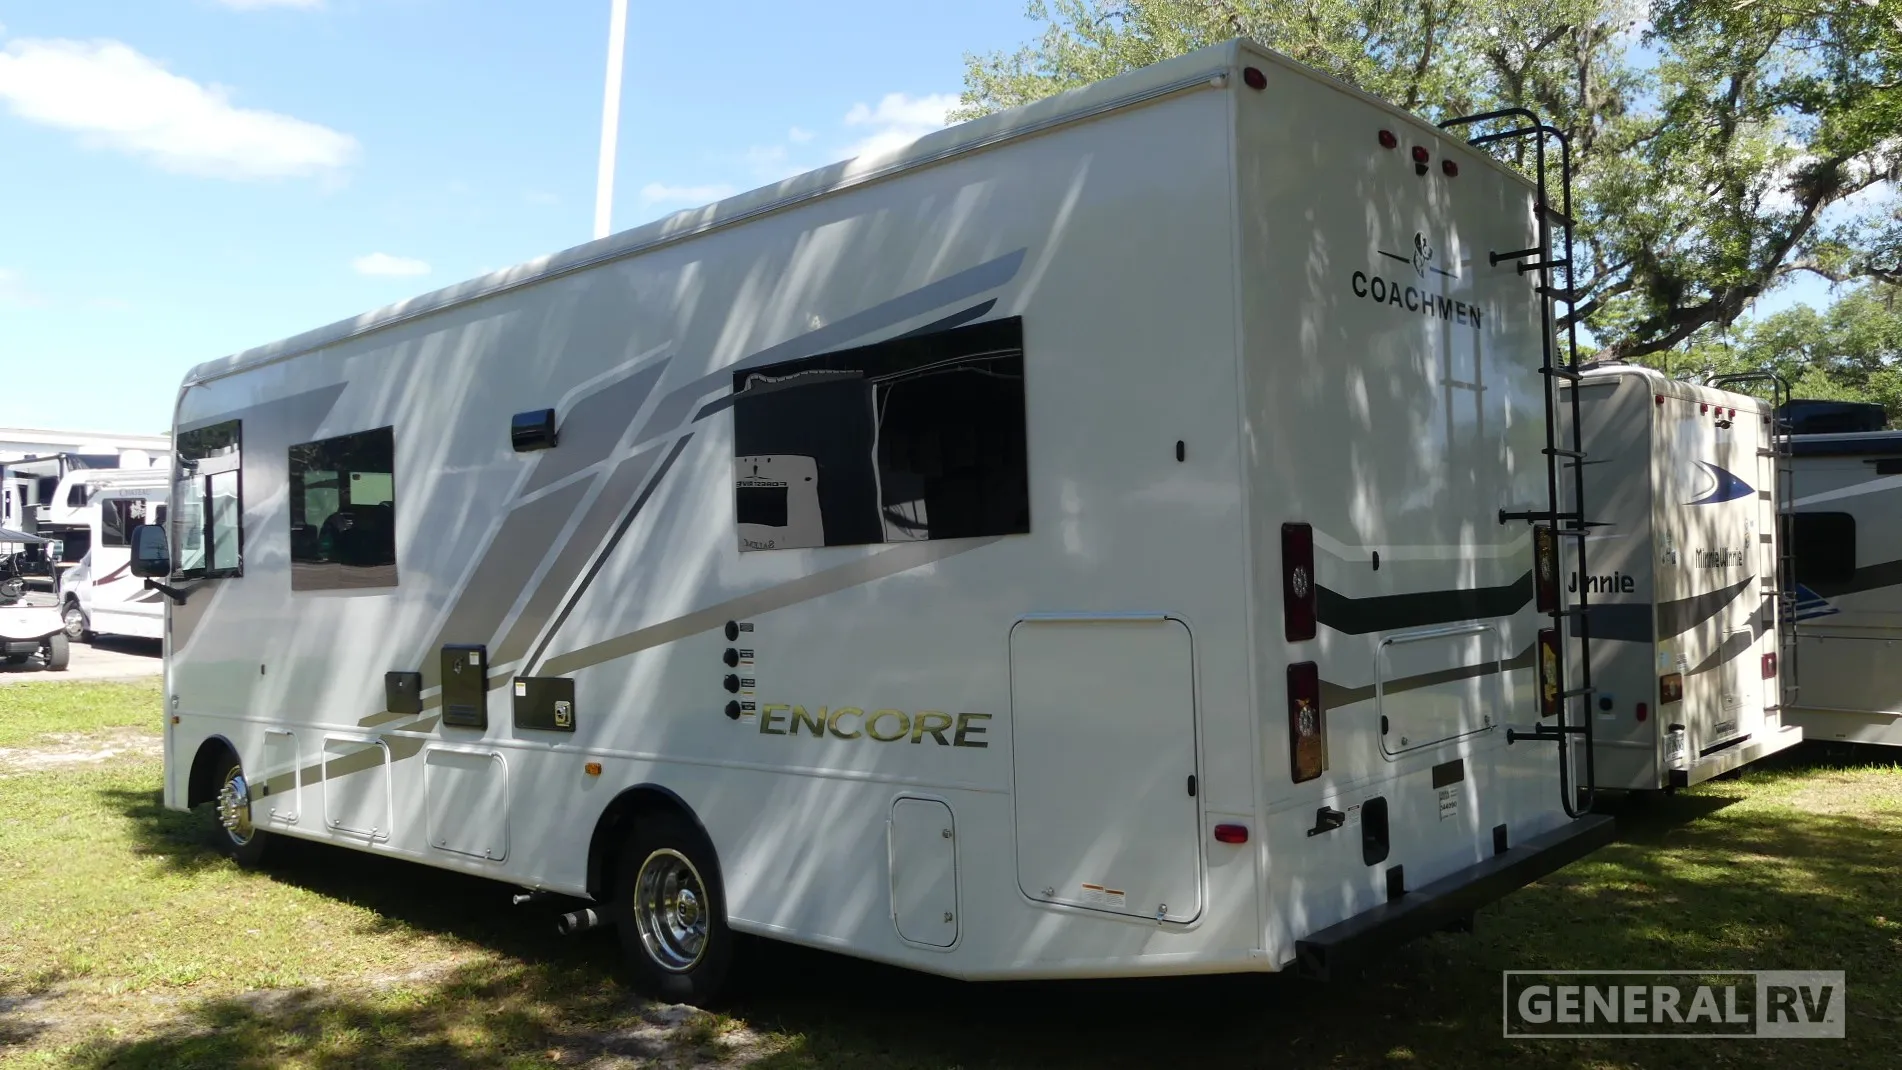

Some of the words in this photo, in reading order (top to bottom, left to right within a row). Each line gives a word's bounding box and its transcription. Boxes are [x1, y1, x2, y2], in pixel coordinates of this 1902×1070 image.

[1352, 270, 1481, 330] COACHMEN
[1695, 547, 1743, 569] MinnieWinnie
[760, 703, 993, 748] ENCORE
